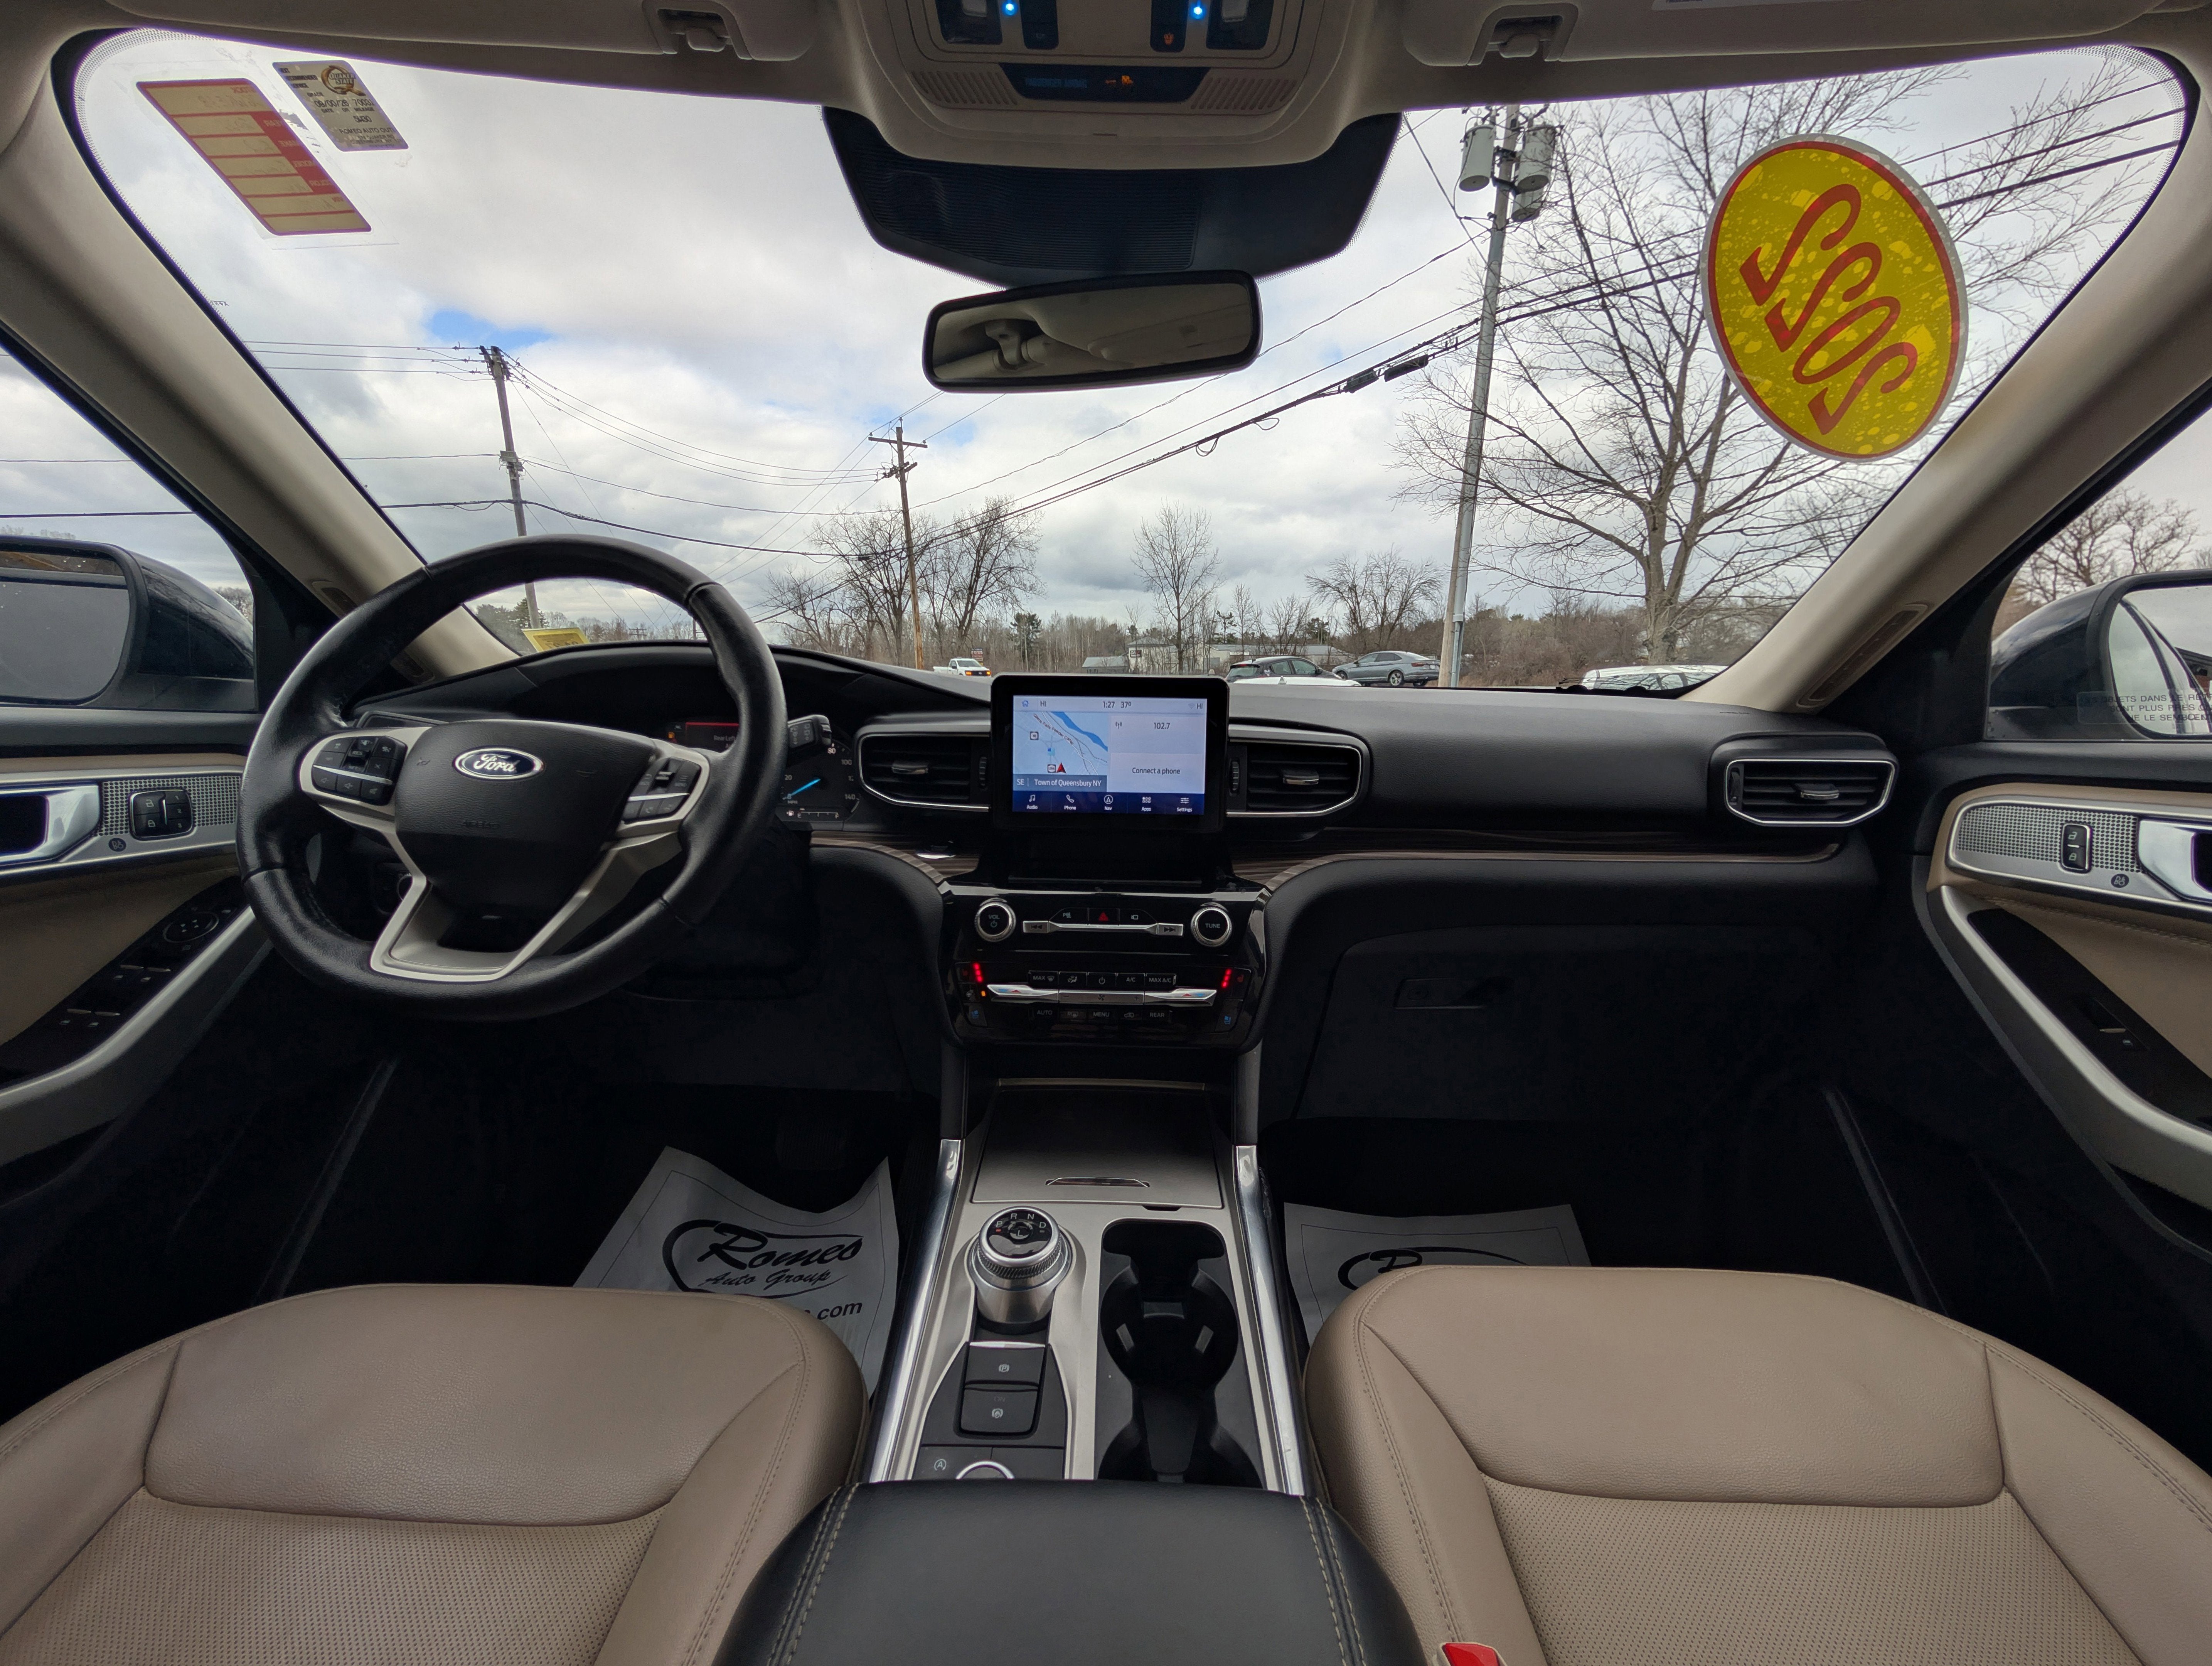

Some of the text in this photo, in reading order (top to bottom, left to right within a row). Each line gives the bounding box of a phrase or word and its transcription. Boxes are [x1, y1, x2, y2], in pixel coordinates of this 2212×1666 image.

[473, 753, 521, 772] Ford
[1162, 767, 1181, 776] phone
[1058, 779, 1092, 788] Queensbury
[697, 1223, 863, 1271] Romeo
[697, 1268, 832, 1290] Auto Group
